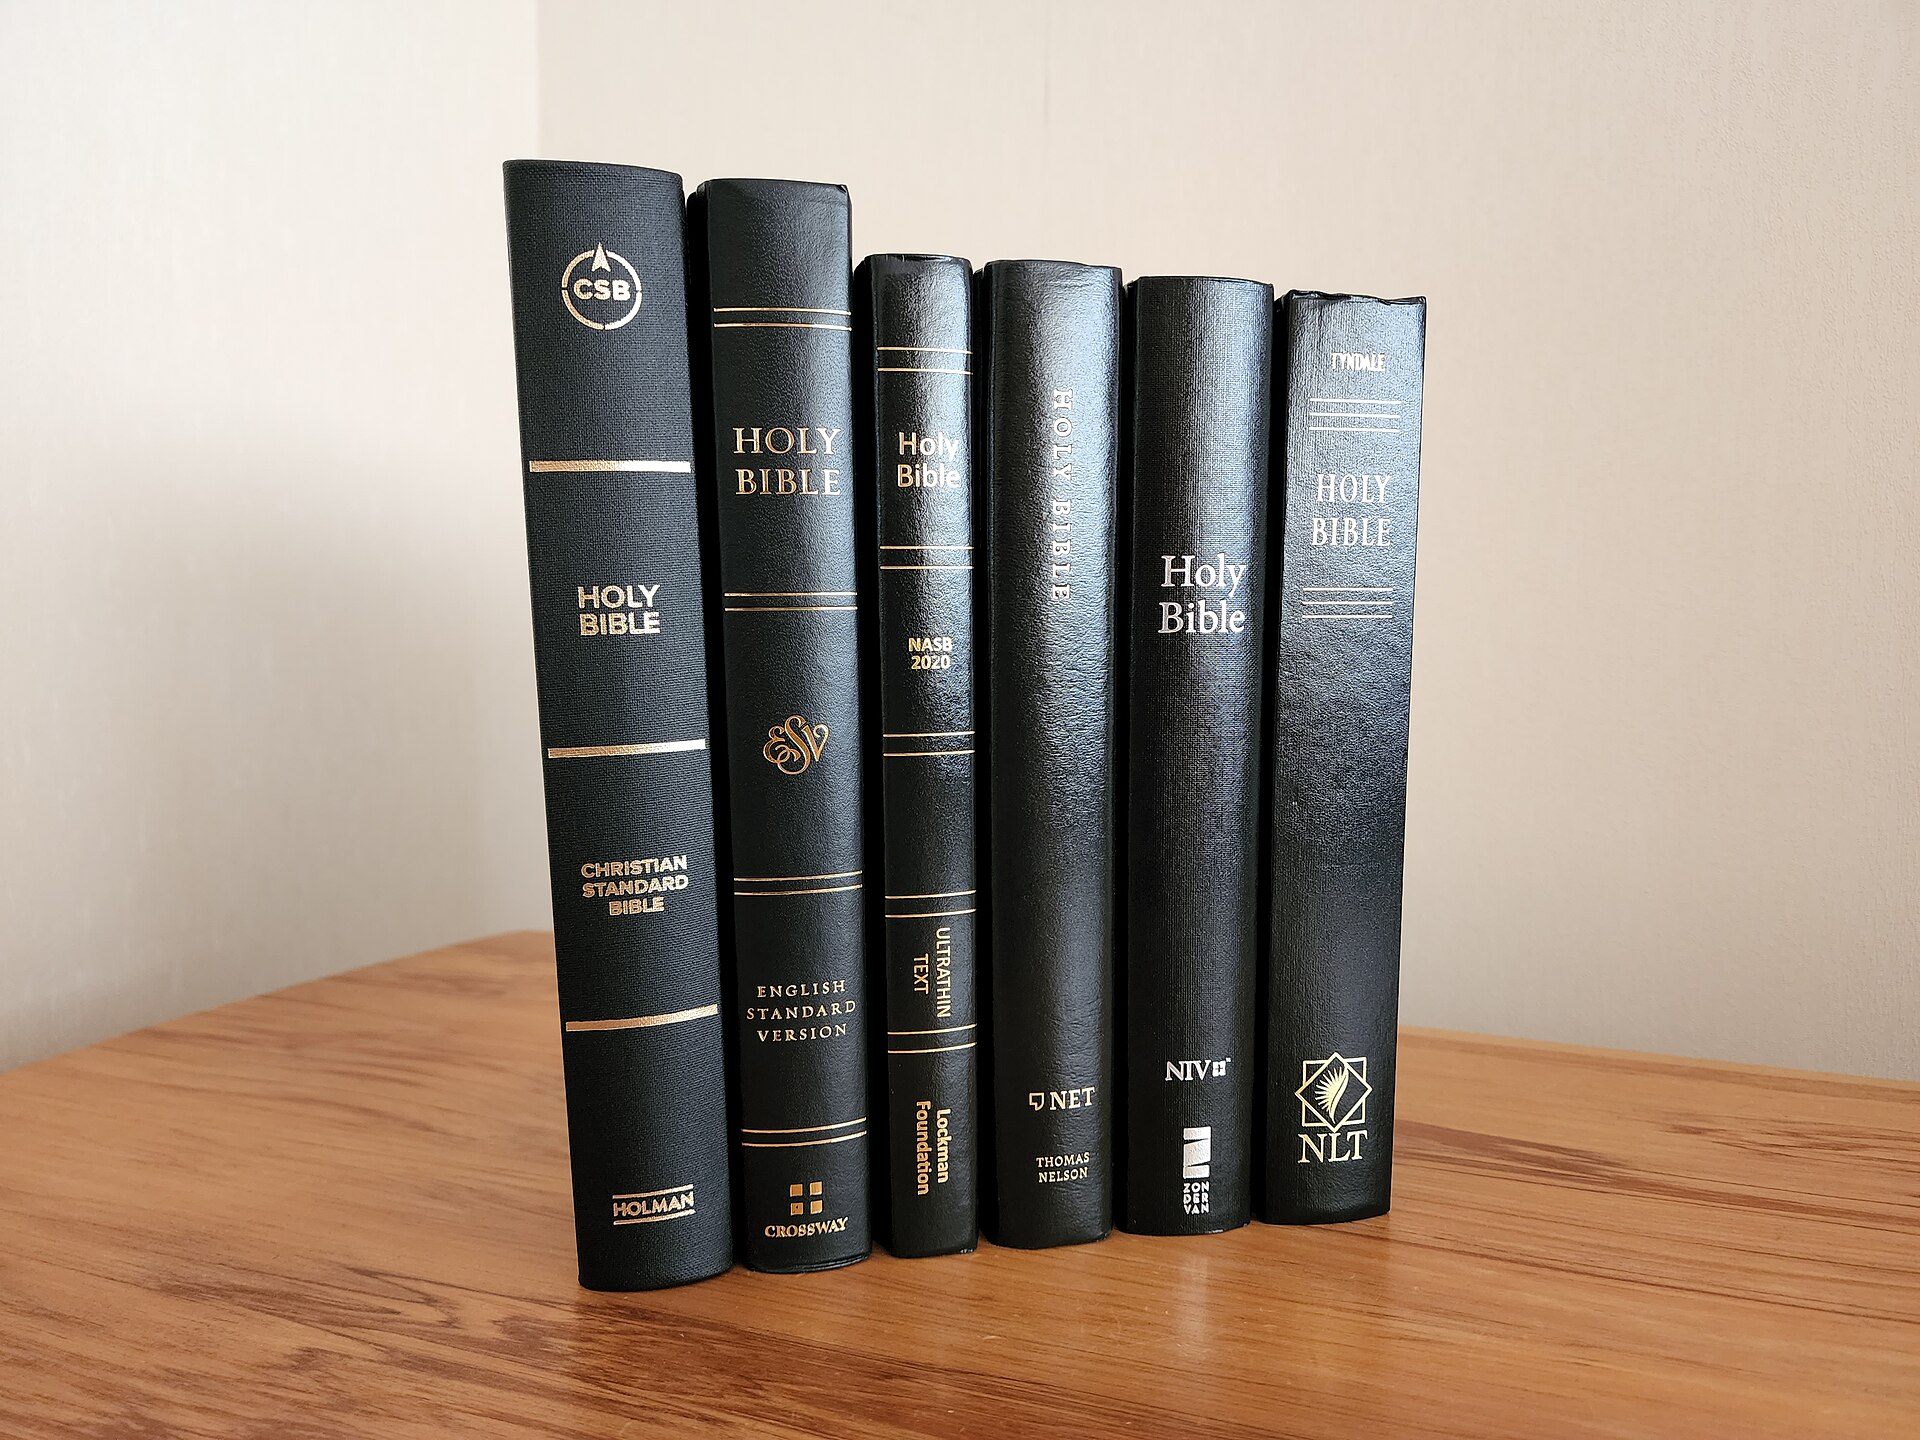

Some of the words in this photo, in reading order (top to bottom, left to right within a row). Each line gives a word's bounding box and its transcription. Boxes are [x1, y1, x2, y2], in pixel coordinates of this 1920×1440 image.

[573, 277, 631, 301] CSB
[1331, 352, 1386, 372] TYNDALE
[733, 427, 842, 455] HOLY
[898, 431, 960, 460] Holy
[1053, 389, 1073, 483] HOLY
[735, 469, 842, 496] BIBLE
[897, 464, 960, 488] Bible
[1317, 473, 1392, 505] HOLY
[1311, 517, 1391, 548] BIBLE
[1053, 498, 1073, 601] BIBLE
[1161, 553, 1246, 597] Holy
[578, 585, 660, 608] HOLY
[579, 612, 660, 635] BIBLE
[1157, 600, 1245, 635] Bible
[908, 637, 953, 653] NASB
[911, 655, 951, 670] 2020
[763, 715, 828, 775] ESV
[581, 855, 688, 876] CHRISTIAN
[582, 875, 689, 897] STANDARD
[609, 896, 665, 916] BIBLE
[913, 953, 930, 995] TEXT
[936, 927, 951, 1018] ULTRATHIN
[757, 978, 846, 998] ENGLISH
[747, 1000, 856, 1019] STANDARD
[757, 1022, 848, 1043] VERSION
[1165, 1060, 1211, 1081] NIV
[1049, 1086, 1095, 1109] NET
[915, 1100, 933, 1195] Foundation
[935, 1108, 953, 1184] Lockman
[1298, 1129, 1367, 1163] NLT
[1036, 1152, 1090, 1168] THOMAS
[1038, 1168, 1088, 1184] NELSON
[612, 1191, 694, 1218] HOLMAN
[765, 1216, 848, 1239] CROSSWAY
